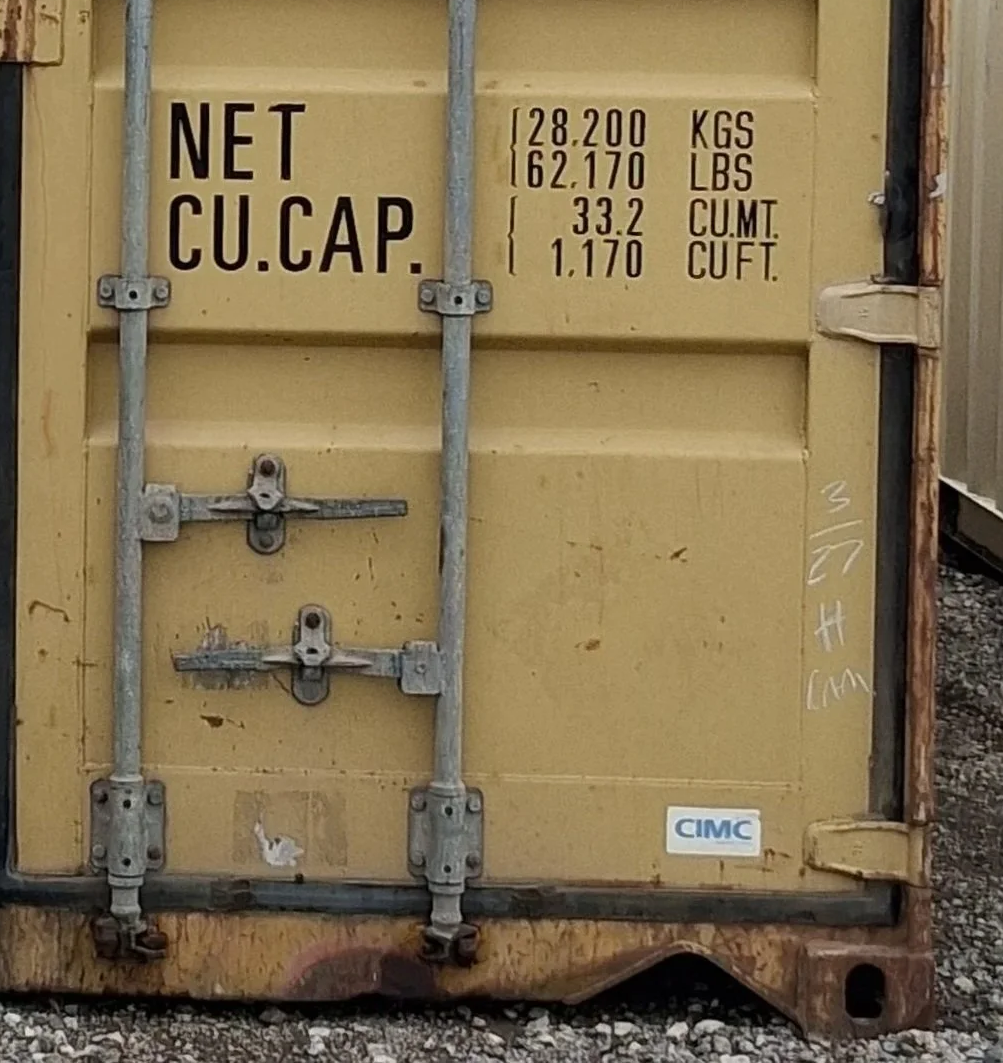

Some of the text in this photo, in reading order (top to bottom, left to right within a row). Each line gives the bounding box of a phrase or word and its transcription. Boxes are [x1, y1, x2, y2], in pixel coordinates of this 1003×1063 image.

[169, 101, 307, 181] NET
[691, 109, 755, 150] KGS
[689, 151, 753, 192] LBS
[572, 196, 779, 240] 33.2 CU.MT.
[674, 818, 752, 841] CIMC
